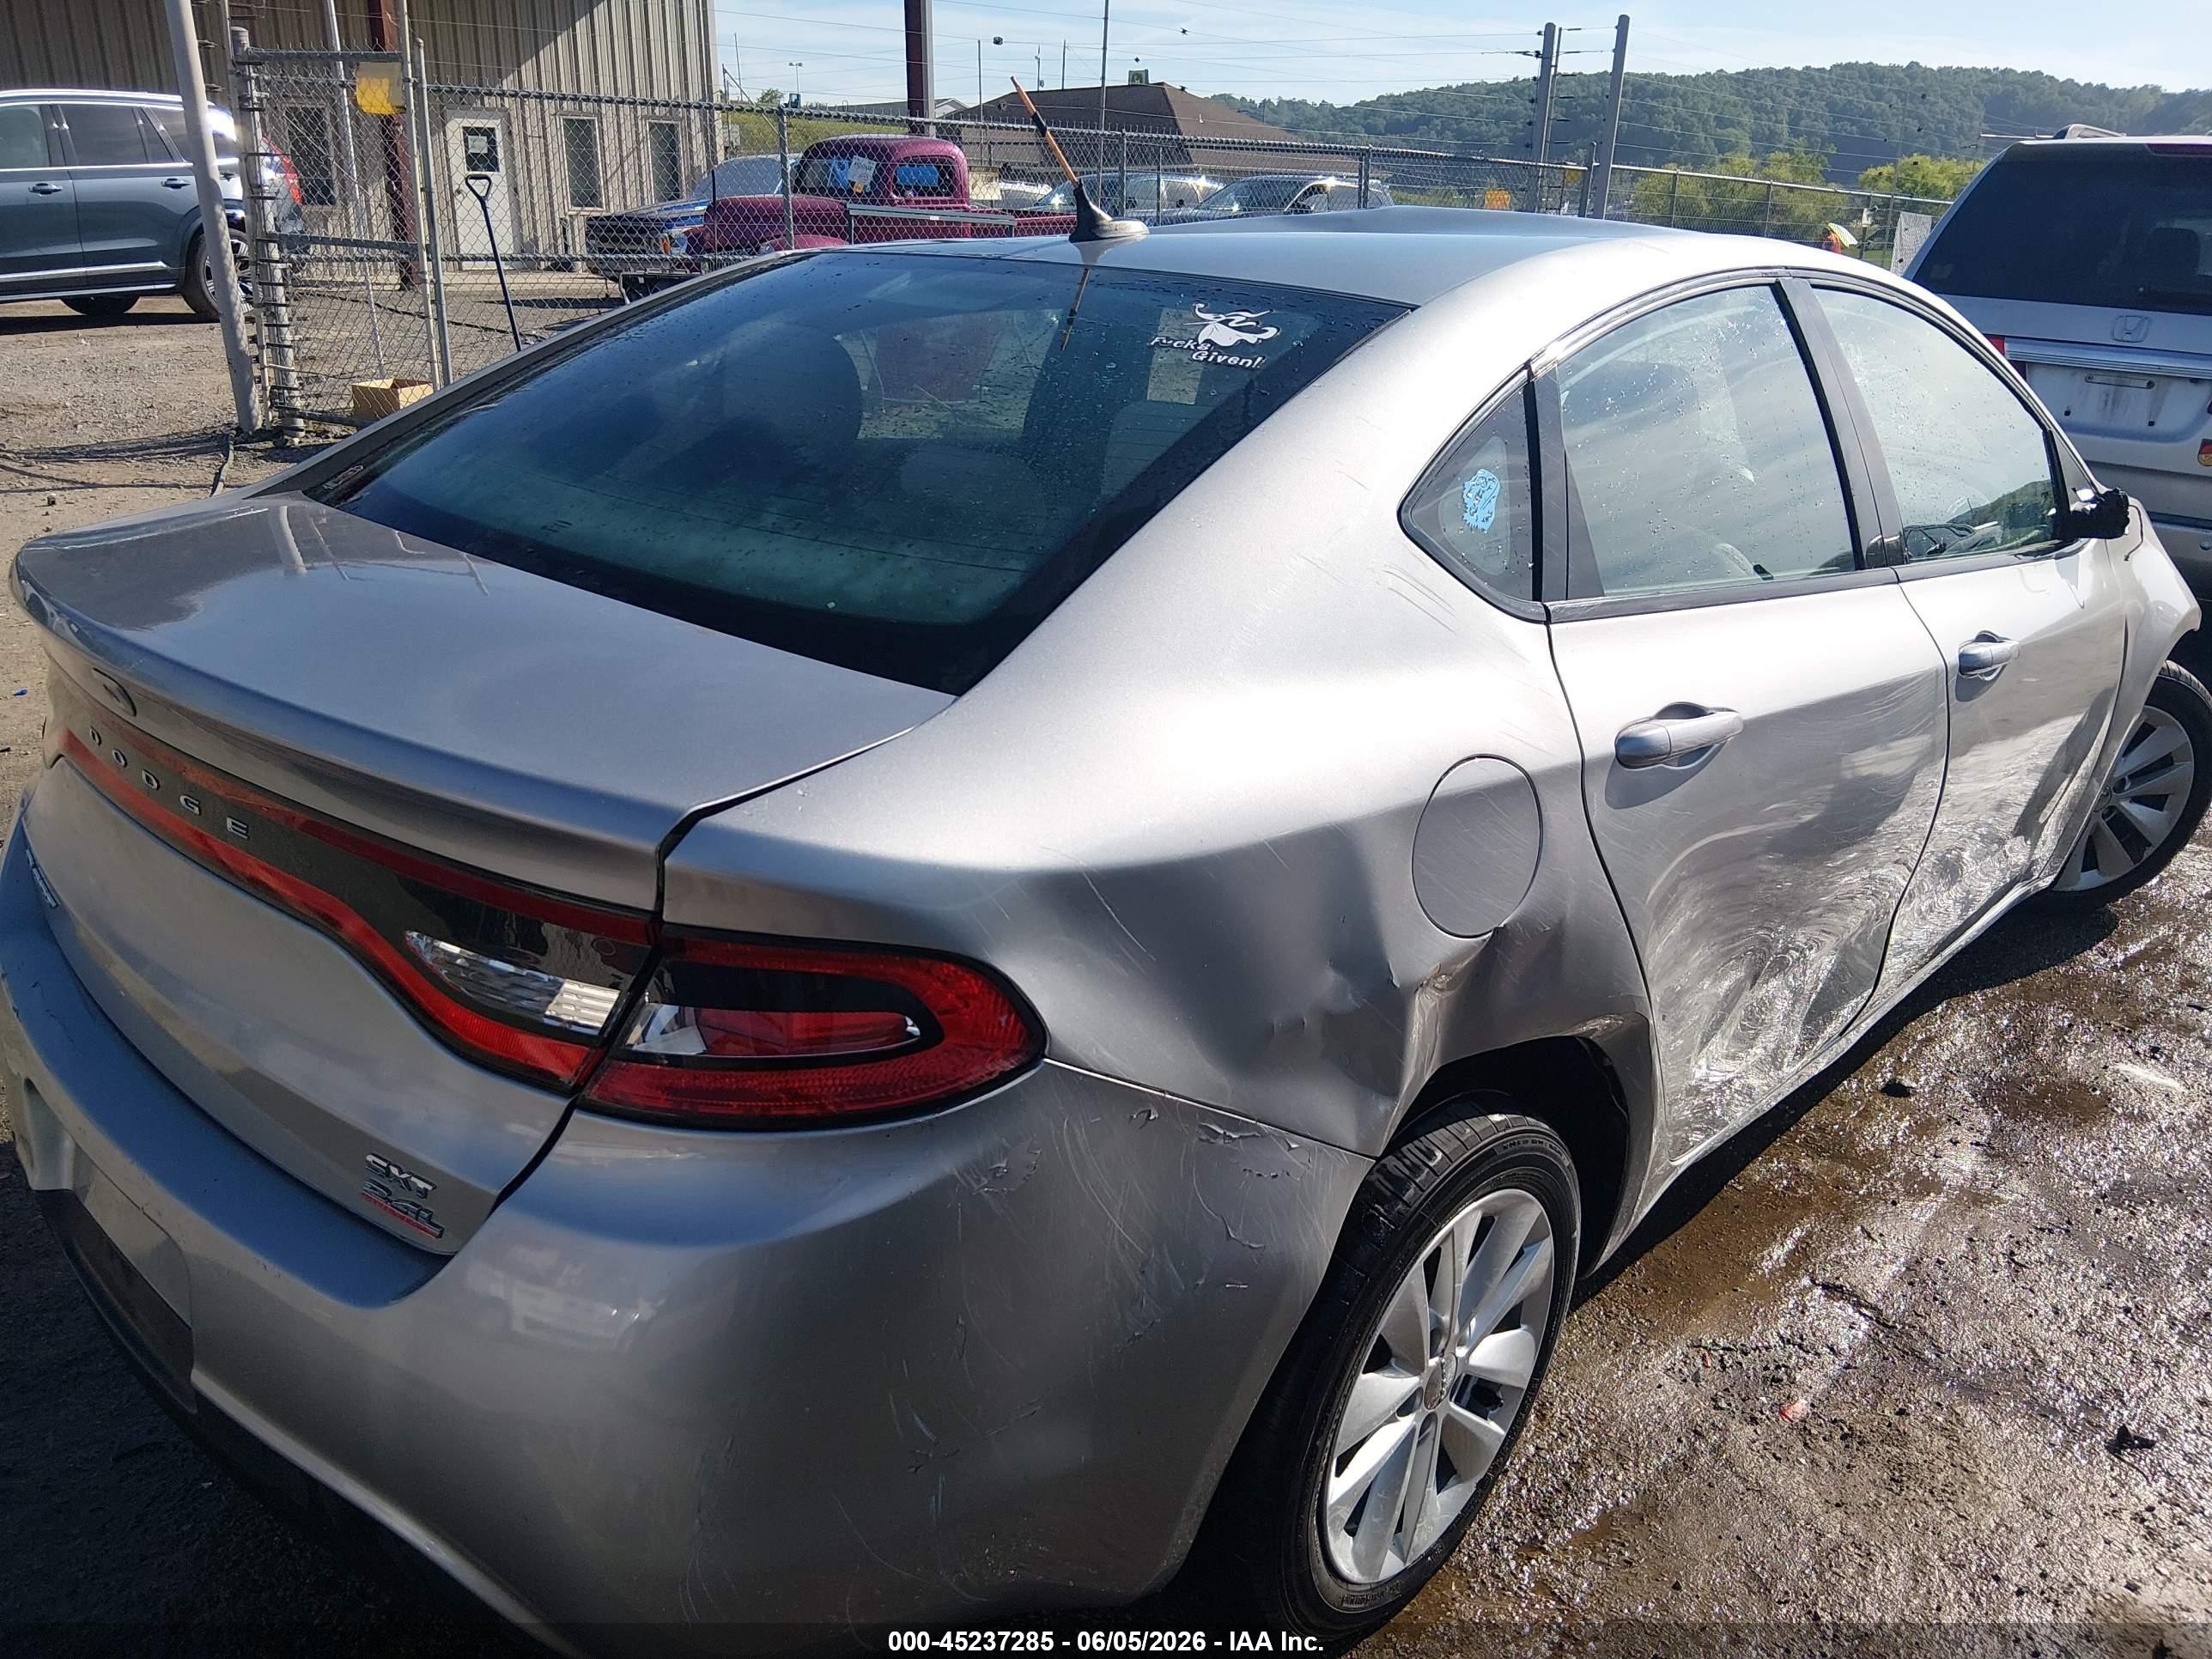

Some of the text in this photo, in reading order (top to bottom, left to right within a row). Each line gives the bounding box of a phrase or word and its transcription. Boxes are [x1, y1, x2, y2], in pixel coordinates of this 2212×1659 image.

[1193, 351, 1263, 368] Given!
[89, 726, 249, 839] DODGE
[365, 1152, 436, 1199] SXT
